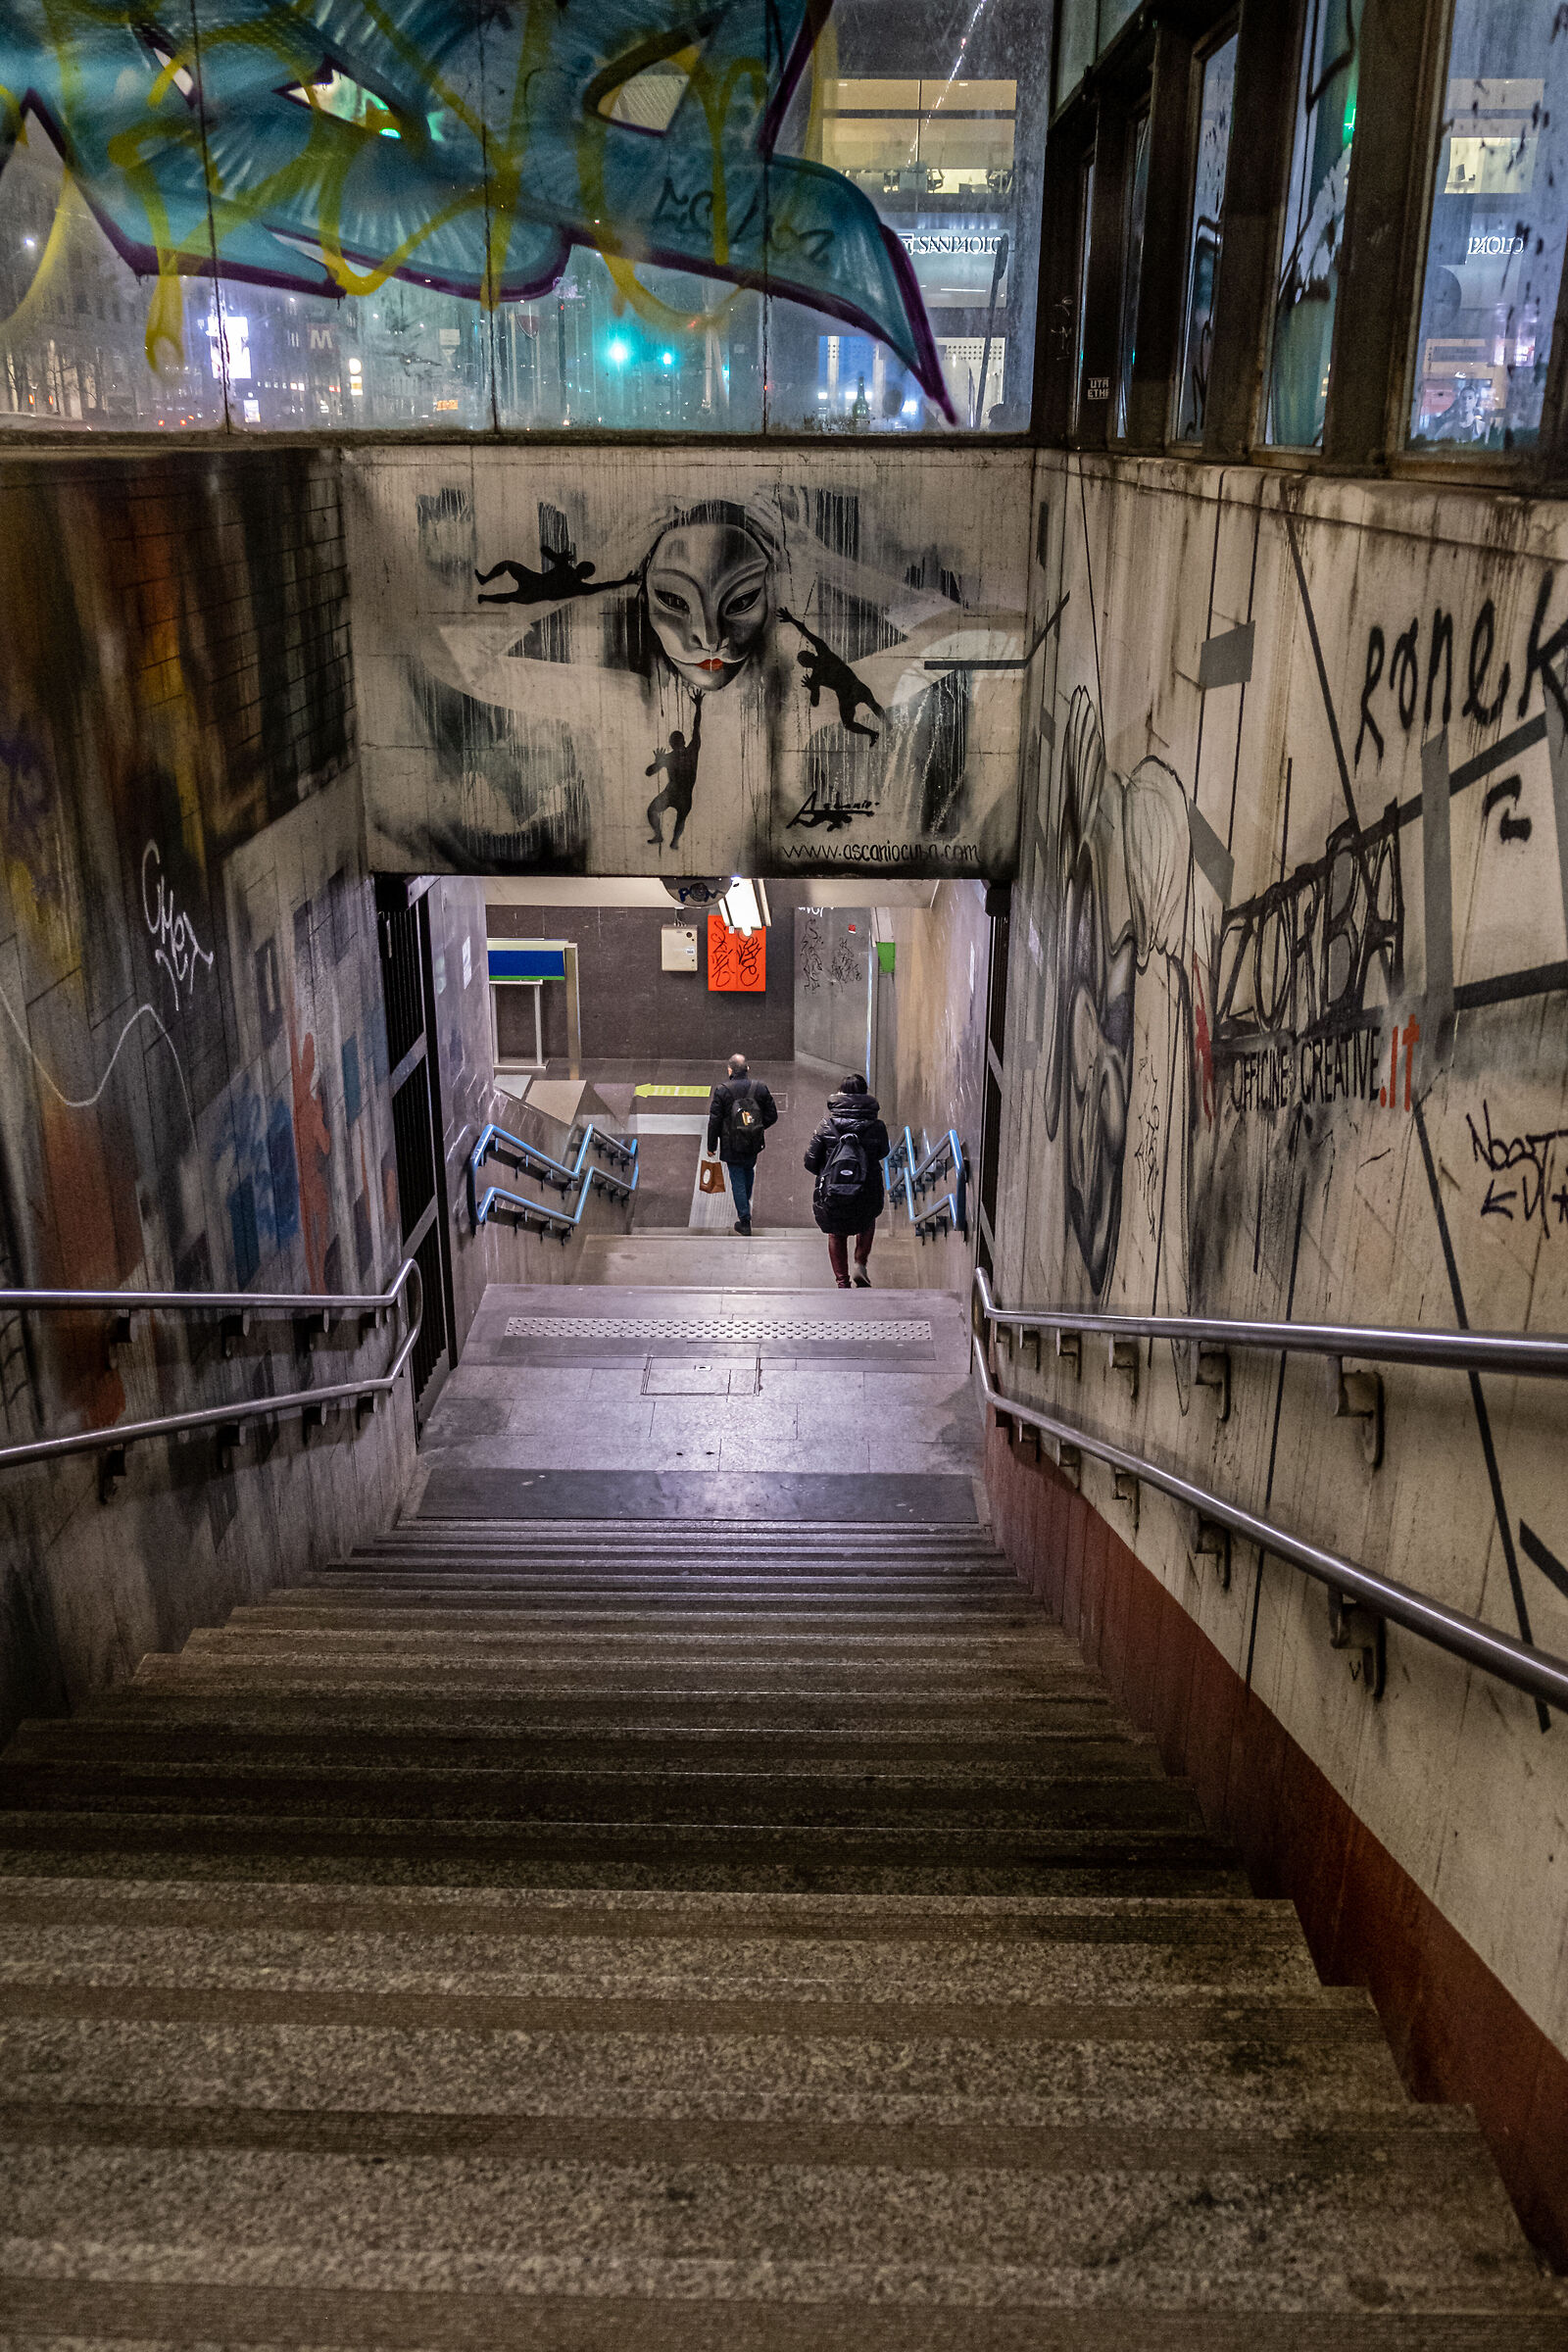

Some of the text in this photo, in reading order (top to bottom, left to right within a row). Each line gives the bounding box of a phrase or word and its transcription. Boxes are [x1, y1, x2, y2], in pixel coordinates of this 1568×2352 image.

[918, 236, 1003, 254] SANPAOLO
[310, 329, 334, 350] M
[783, 840, 982, 863] www.ascaniocuba.com
